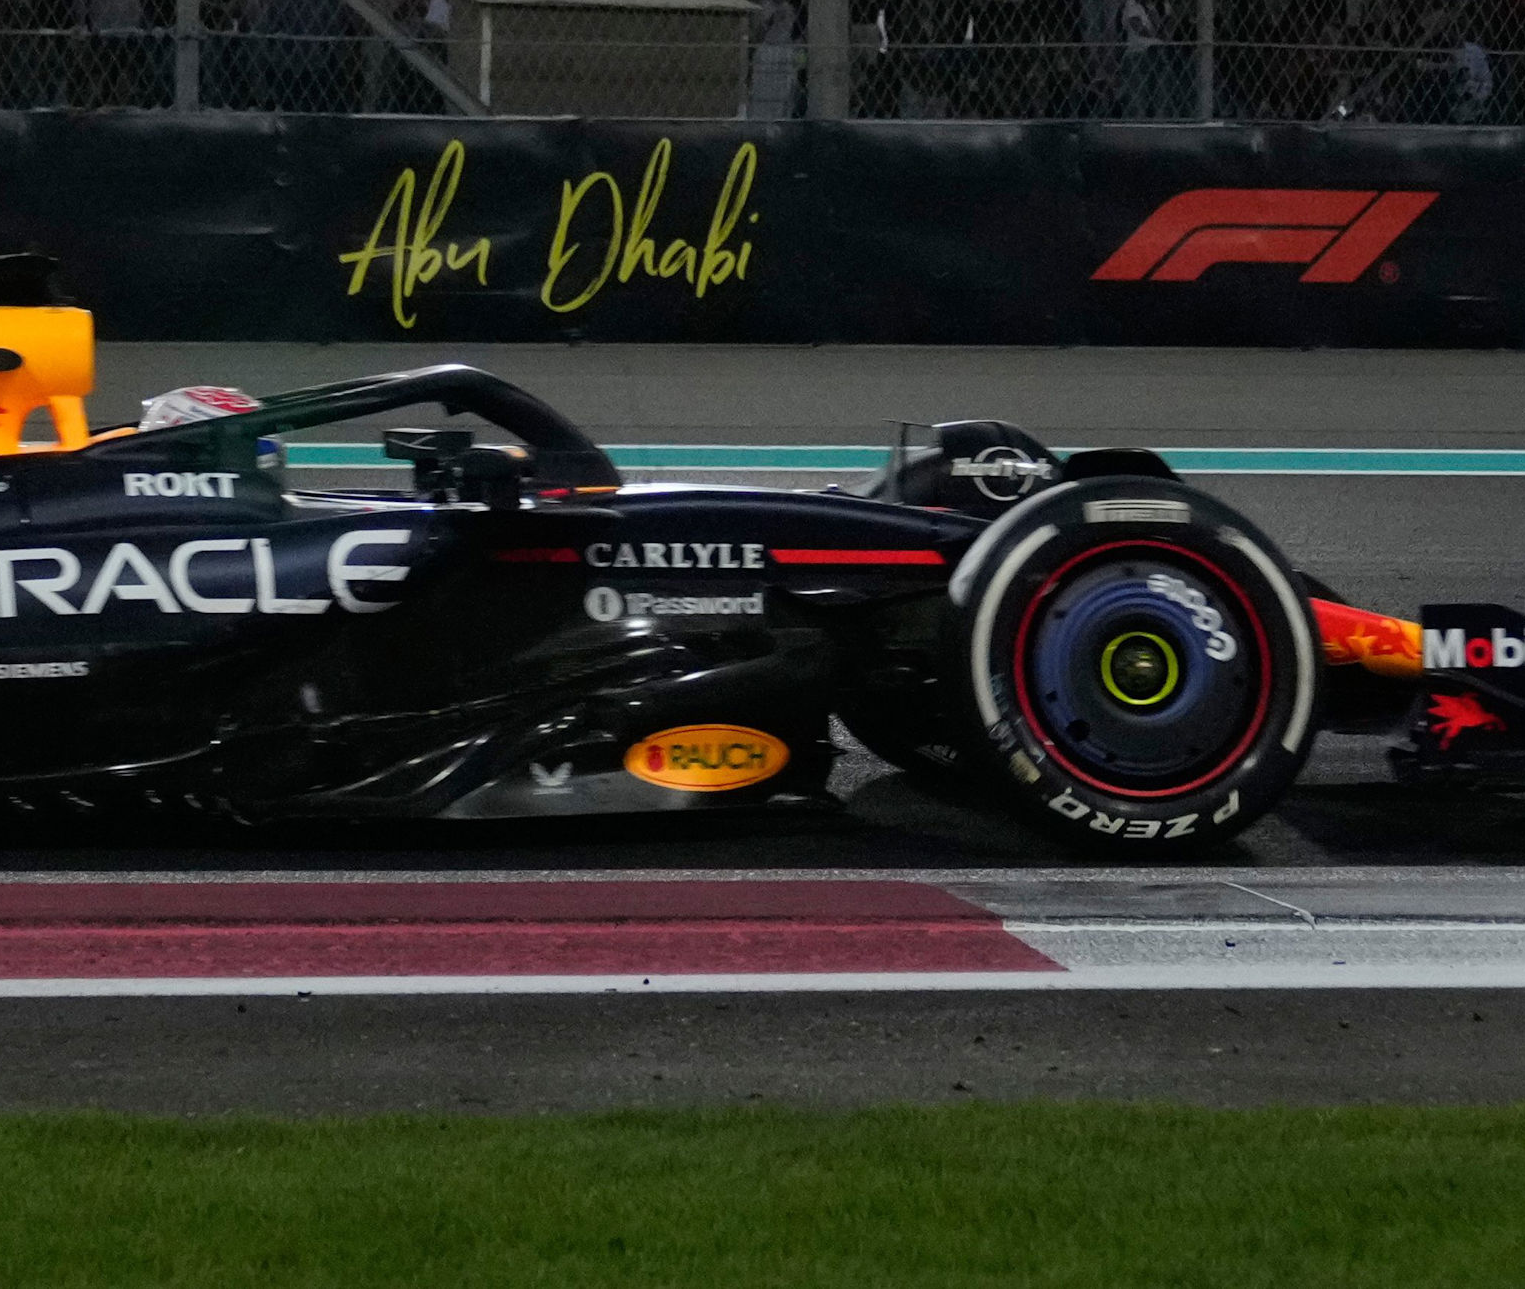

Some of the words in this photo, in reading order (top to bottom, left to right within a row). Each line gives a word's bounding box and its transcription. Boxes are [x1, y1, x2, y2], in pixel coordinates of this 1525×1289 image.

[339, 138, 492, 329] Abu
[540, 137, 759, 313] Dhabi
[122, 471, 240, 499] ROKT
[584, 542, 765, 569] CARLYLE
[668, 743, 768, 770] RAUCH
[1212, 788, 1240, 826] P
